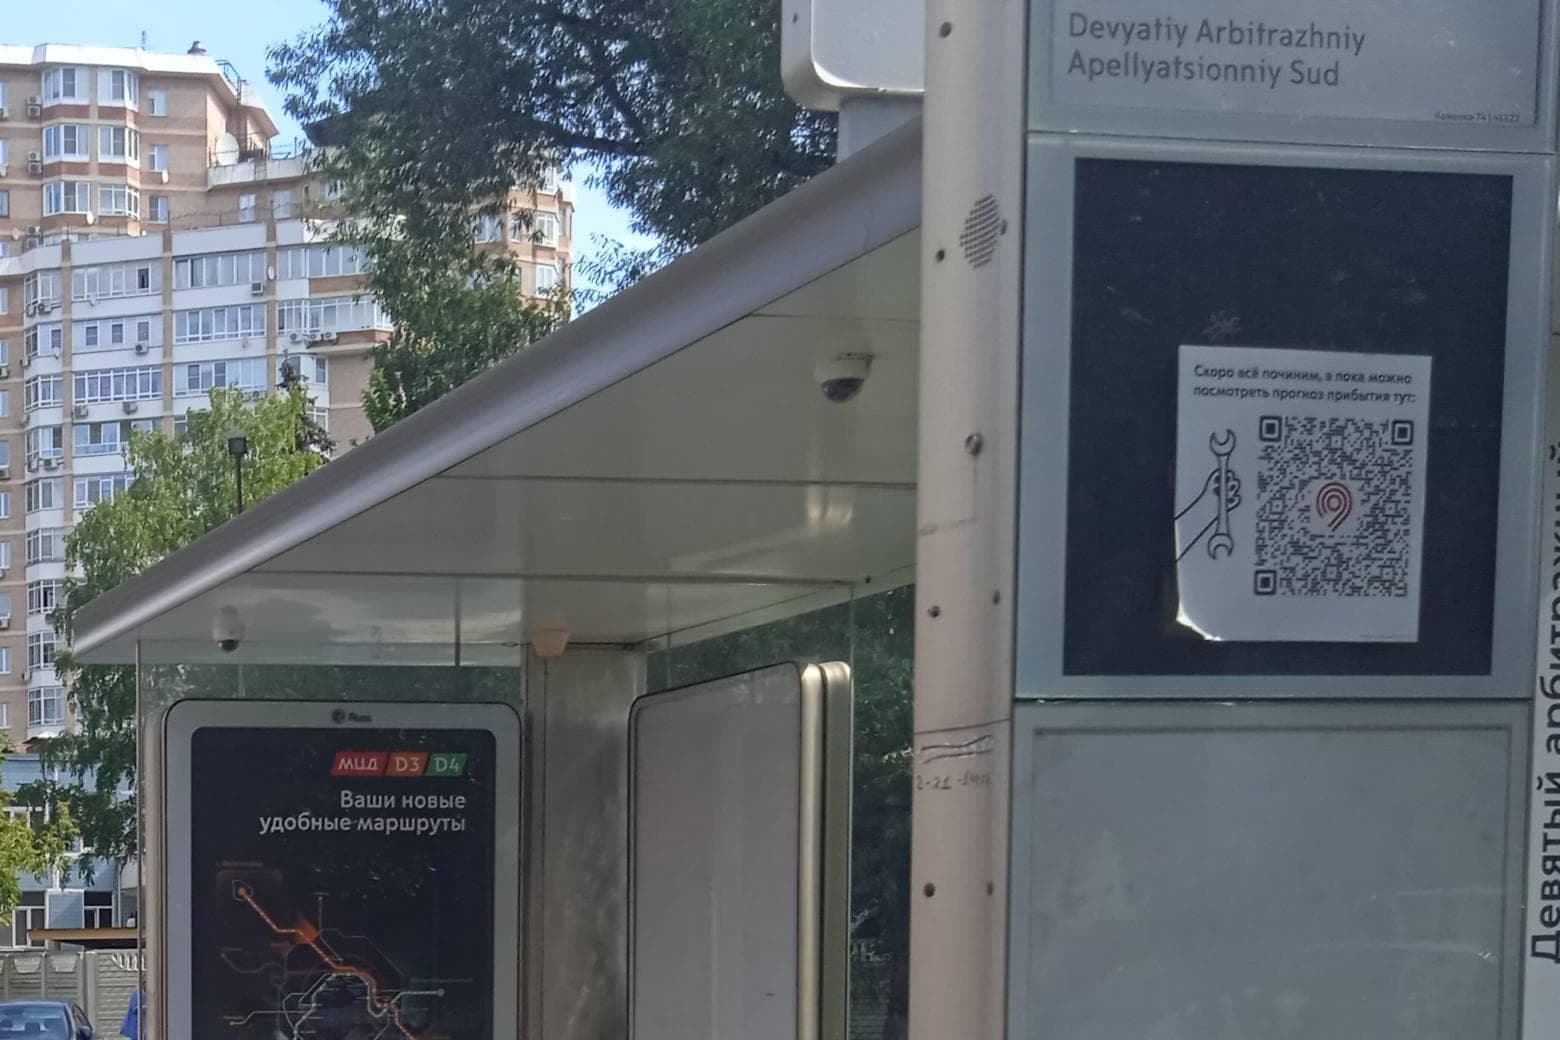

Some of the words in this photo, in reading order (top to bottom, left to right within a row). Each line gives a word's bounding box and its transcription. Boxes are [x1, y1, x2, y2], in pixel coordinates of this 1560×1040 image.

[1069, 12, 1188, 48] Devyatiy
[1195, 18, 1366, 57] Arbitrazhniy
[1067, 49, 1282, 89] Apellyatsionniy
[1290, 59, 1339, 86] Sud
[1194, 364, 1234, 380] Скоро
[1262, 369, 1322, 383] починим,
[1325, 372, 1332, 382] а
[1336, 372, 1365, 382] пока
[1368, 373, 1412, 384] можно
[1193, 387, 1270, 399] посмотреть
[1272, 389, 1324, 401] прогноз
[1327, 388, 1390, 403] прибытия
[337, 757, 379, 771] МЦД
[394, 757, 420, 772] D3
[434, 757, 461, 772] D4
[340, 790, 395, 809] Ваши
[402, 795, 466, 809] новые
[259, 812, 351, 835] удобные
[356, 817, 466, 835] маршруты
[1530, 772, 1560, 965] Девятый
